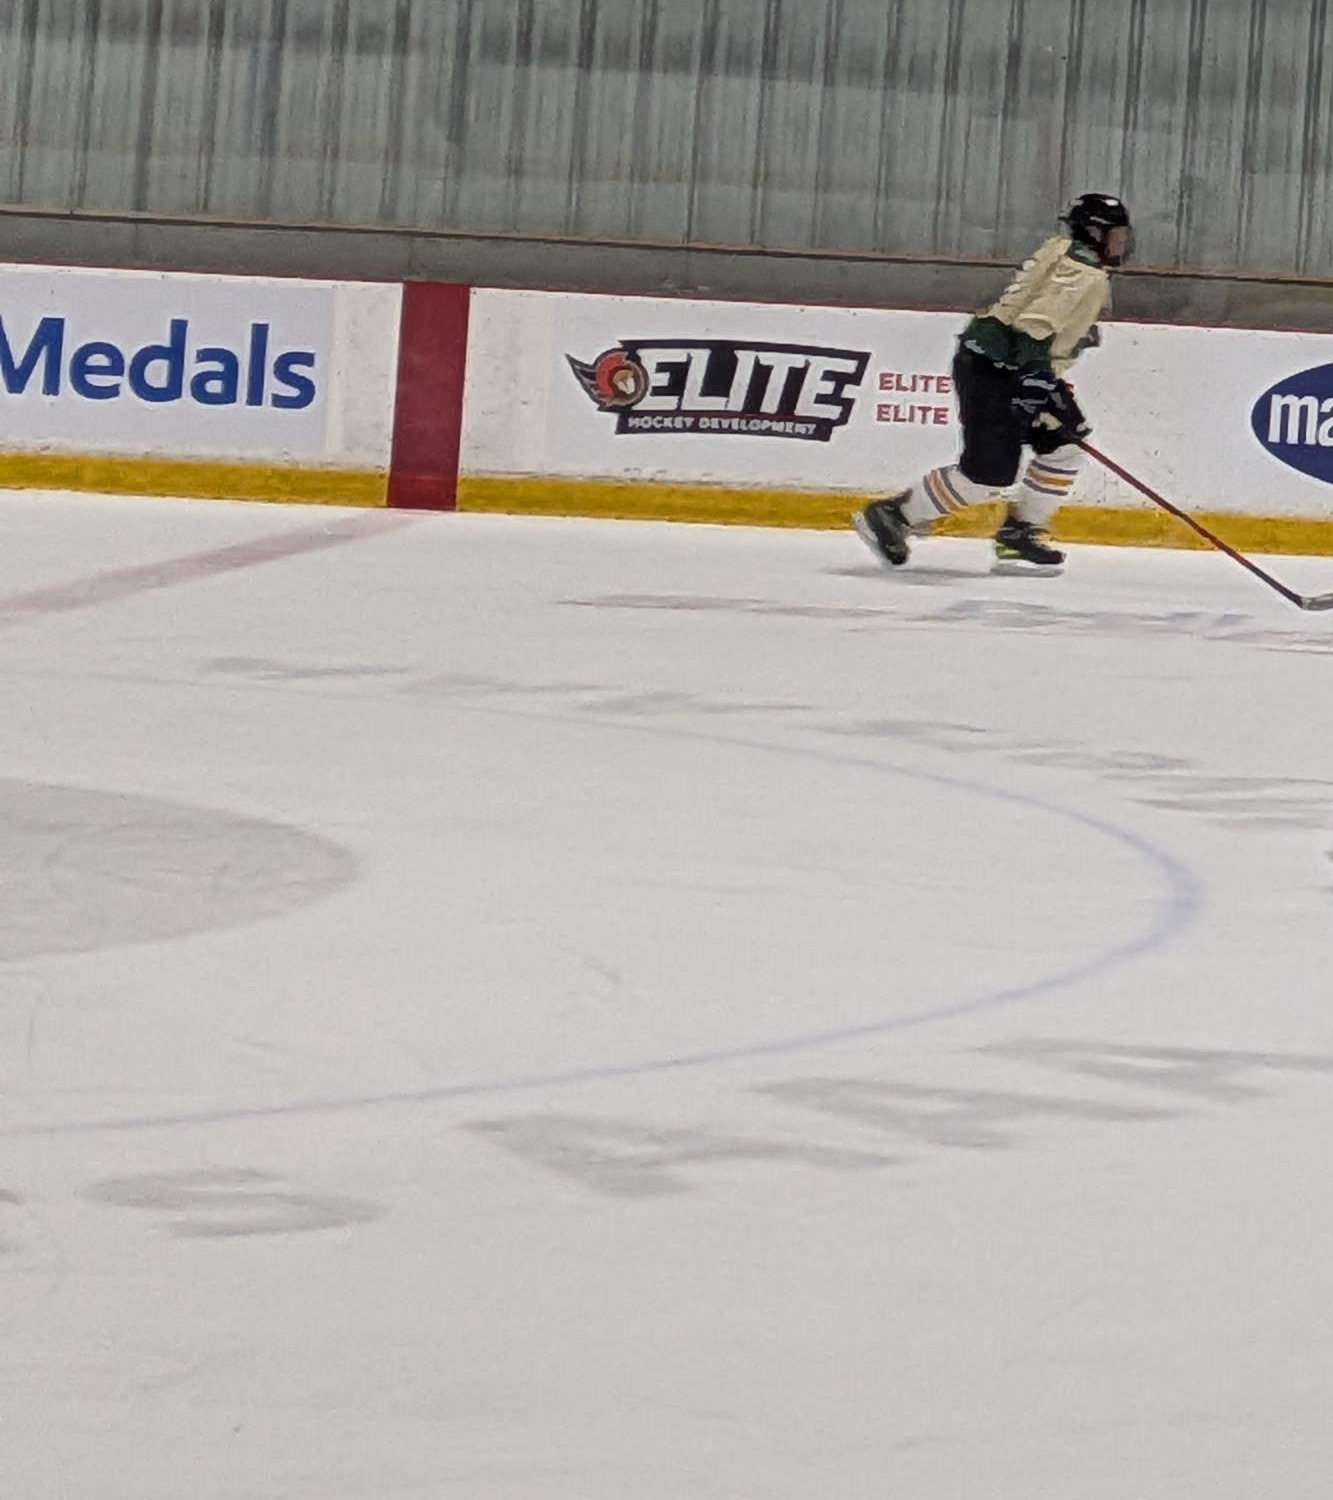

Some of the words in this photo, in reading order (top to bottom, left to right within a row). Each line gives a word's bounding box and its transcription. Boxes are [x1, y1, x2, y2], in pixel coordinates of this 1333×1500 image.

[0, 317, 316, 409] Medals
[631, 348, 859, 419] ELITE
[878, 372, 951, 394] ELITE
[627, 415, 695, 430] HOCKEY
[876, 404, 949, 425] ELITE
[698, 417, 817, 436] DEVELOPMENT
